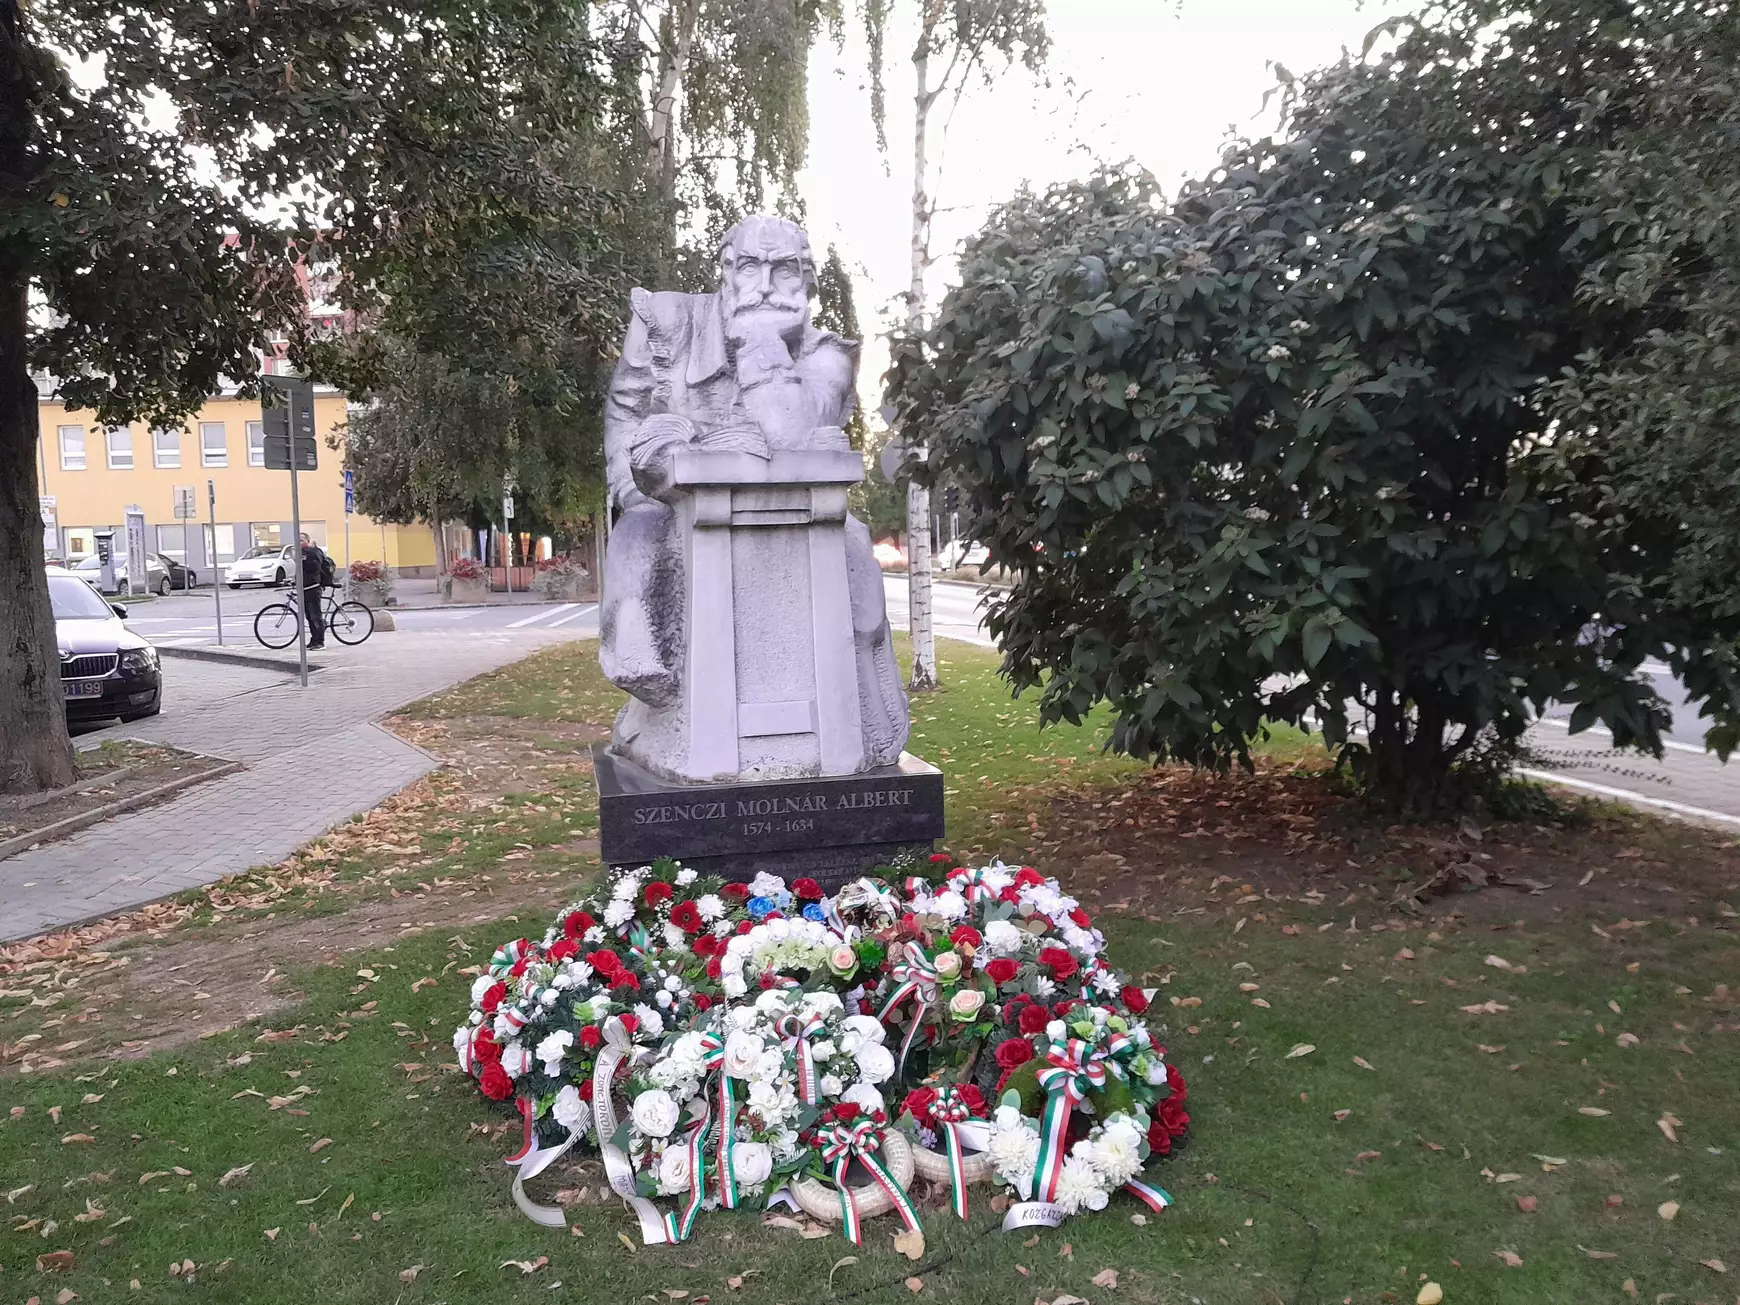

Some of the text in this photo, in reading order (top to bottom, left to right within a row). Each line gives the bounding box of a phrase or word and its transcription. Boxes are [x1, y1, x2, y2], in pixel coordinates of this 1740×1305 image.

[633, 789, 914, 825] SZENCZI MOLNÁR ALBERT
[743, 822, 772, 836] 1574
[785, 819, 814, 832] 1634
